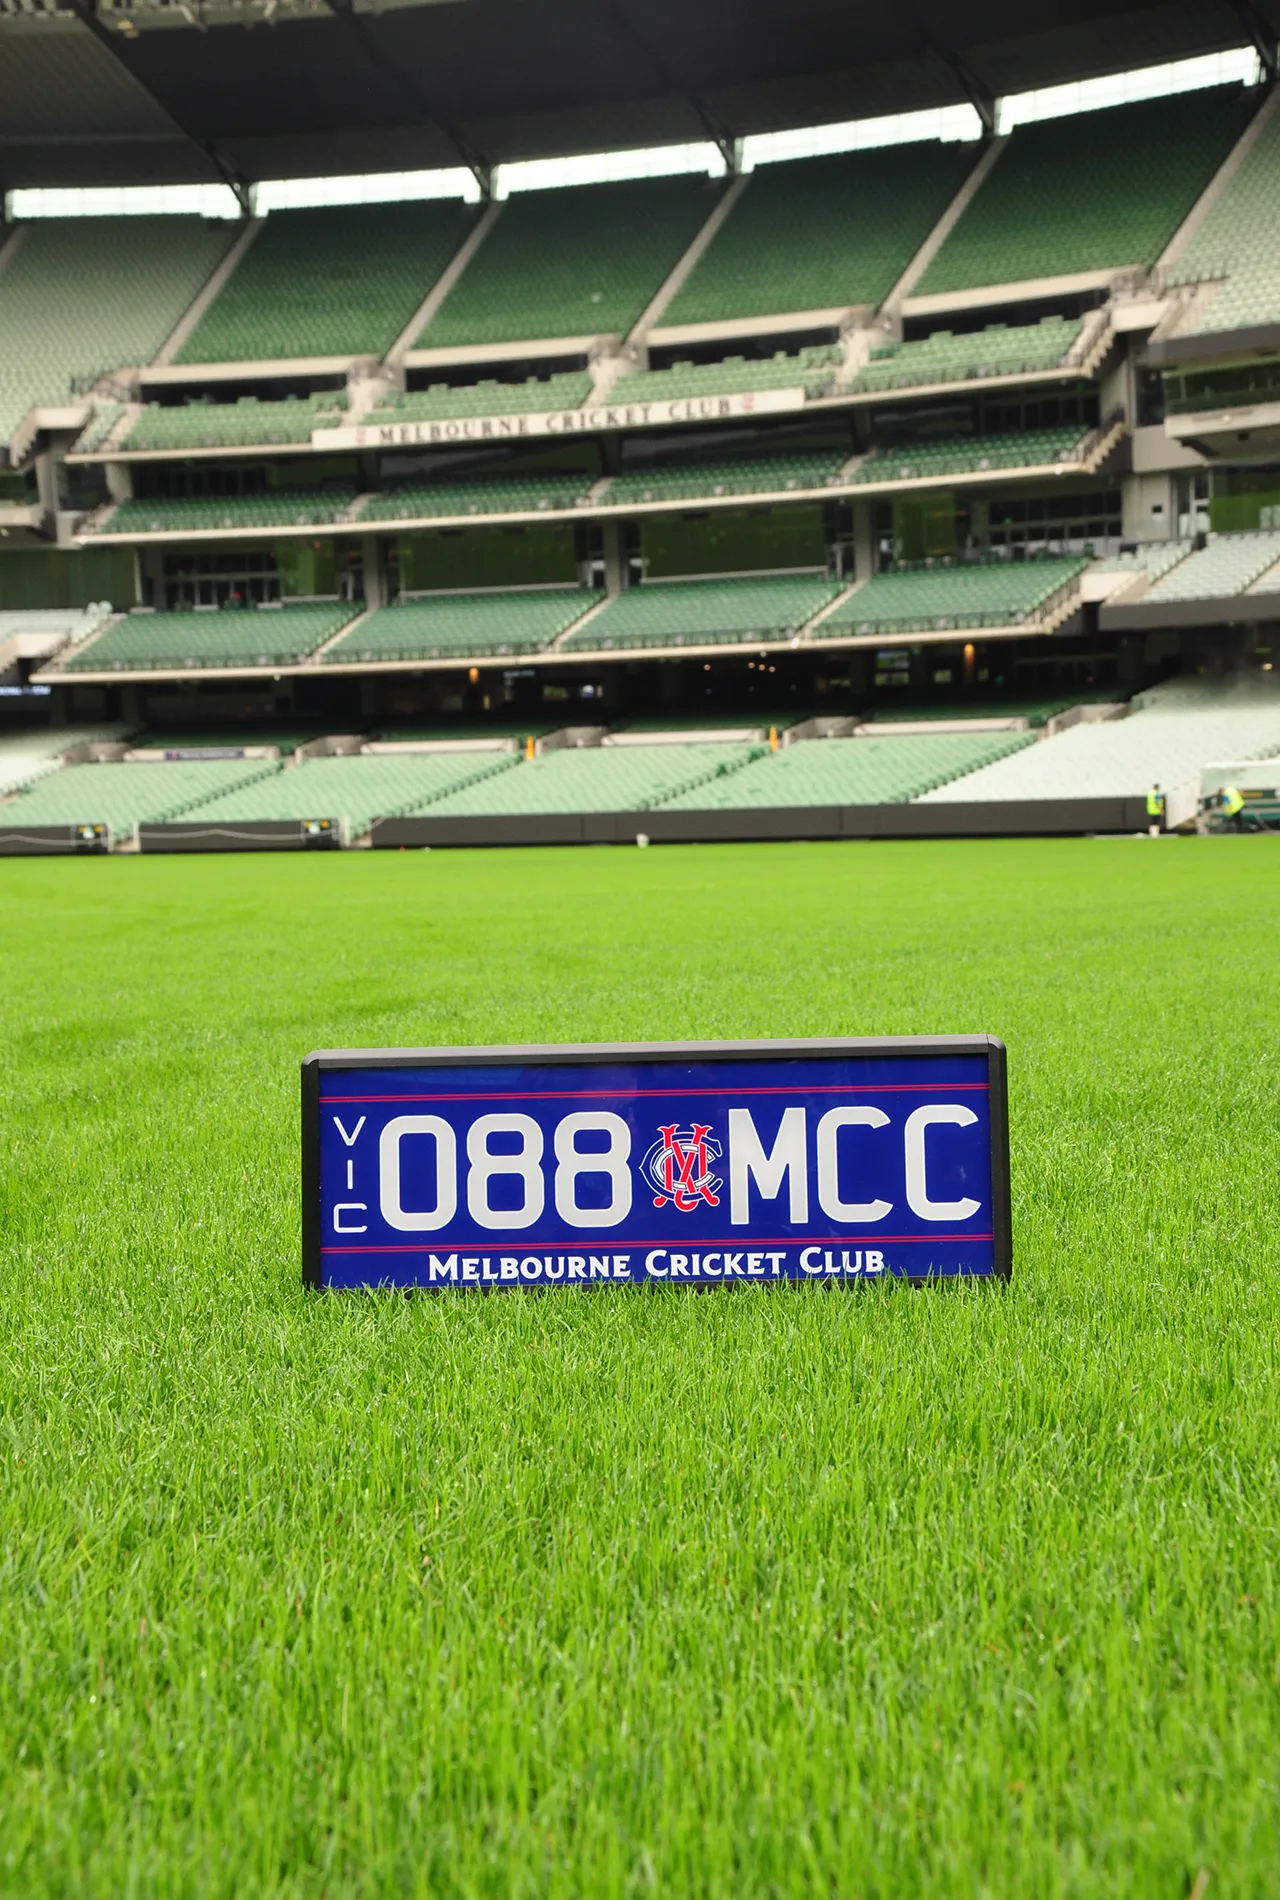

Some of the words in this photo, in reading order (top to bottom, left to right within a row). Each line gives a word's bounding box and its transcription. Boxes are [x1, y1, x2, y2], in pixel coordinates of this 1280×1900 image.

[379, 417, 530, 444] MELBOURNE
[546, 405, 652, 432] CRICKET
[668, 397, 731, 420] CLUB
[333, 1115, 368, 1234] VIC
[379, 1111, 633, 1232] 088
[728, 1104, 982, 1225] MCC
